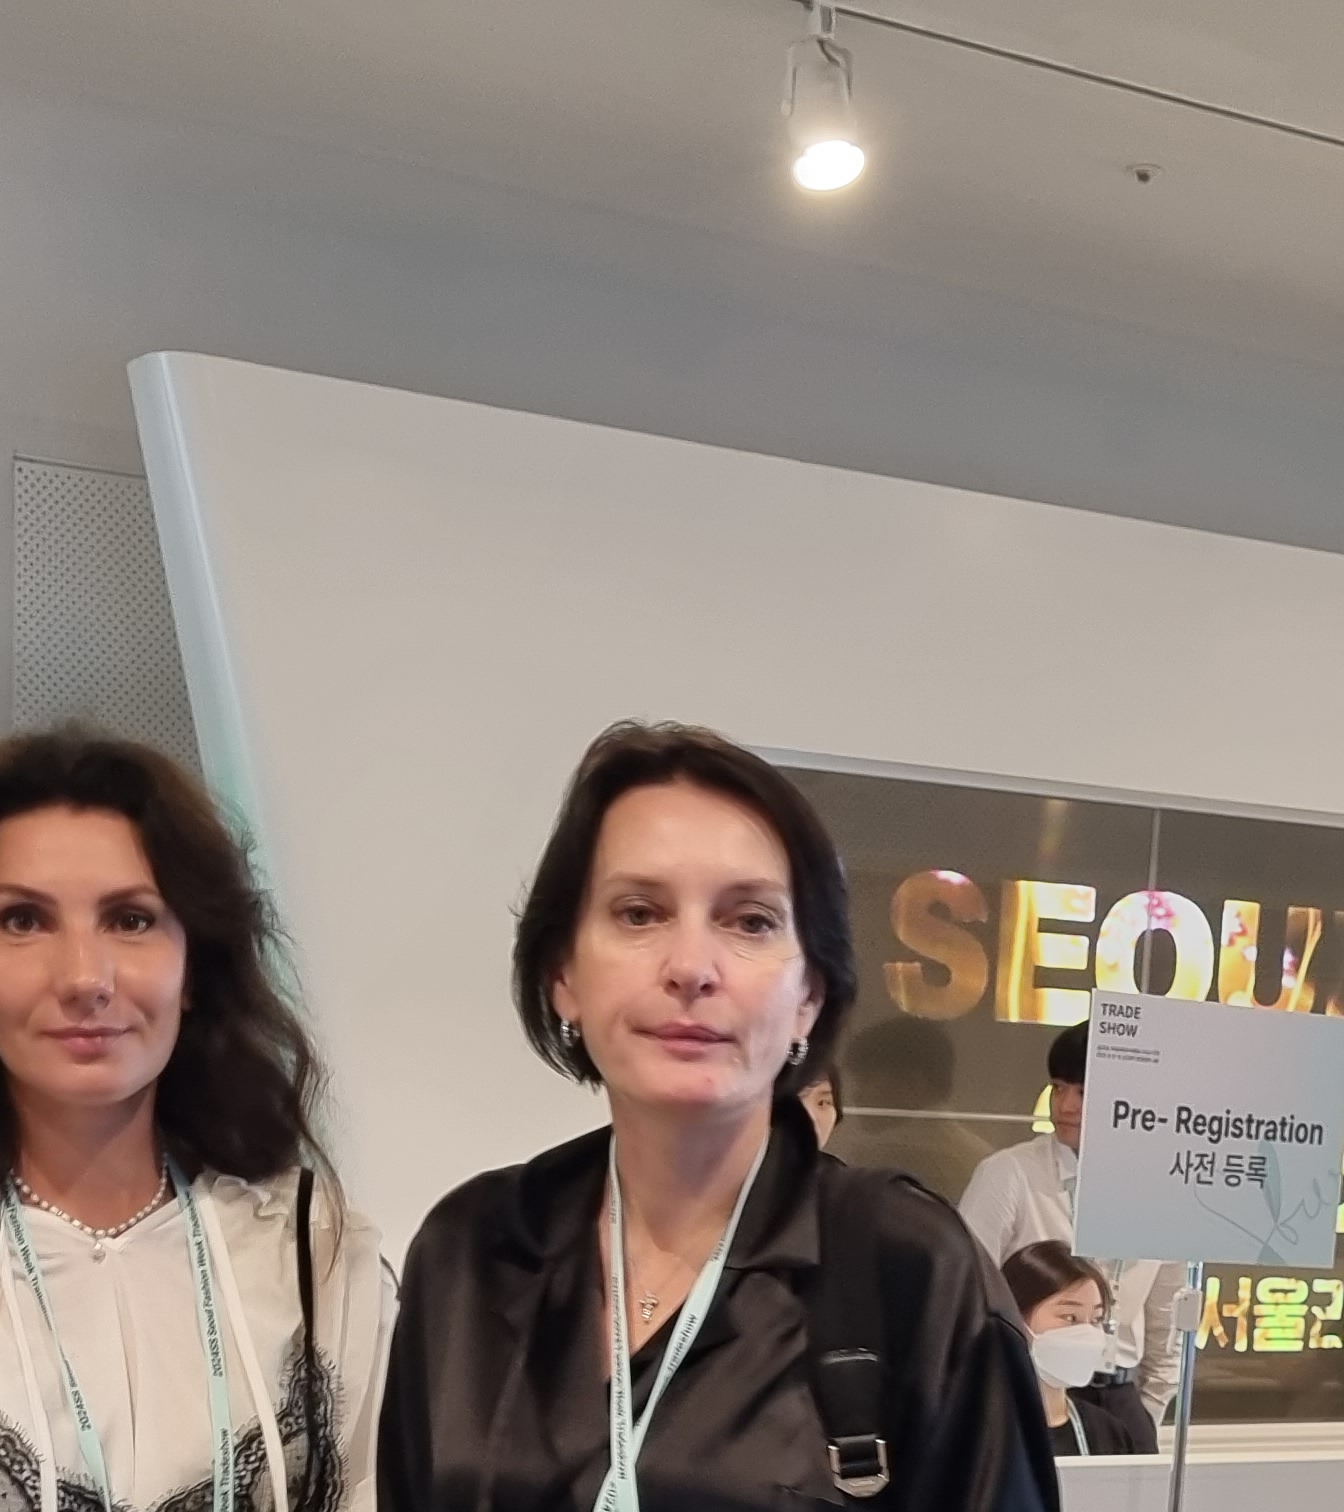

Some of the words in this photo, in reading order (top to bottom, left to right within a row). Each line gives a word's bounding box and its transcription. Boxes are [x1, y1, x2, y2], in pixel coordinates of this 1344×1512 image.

[1101, 1002, 1142, 1020] TRADE
[1099, 1021, 1138, 1038] SHOW
[1112, 1099, 1168, 1132] Pre-
[1175, 1105, 1324, 1146] Registration
[1169, 1150, 1216, 1185] 사전
[1222, 1153, 1268, 1189] 등록
